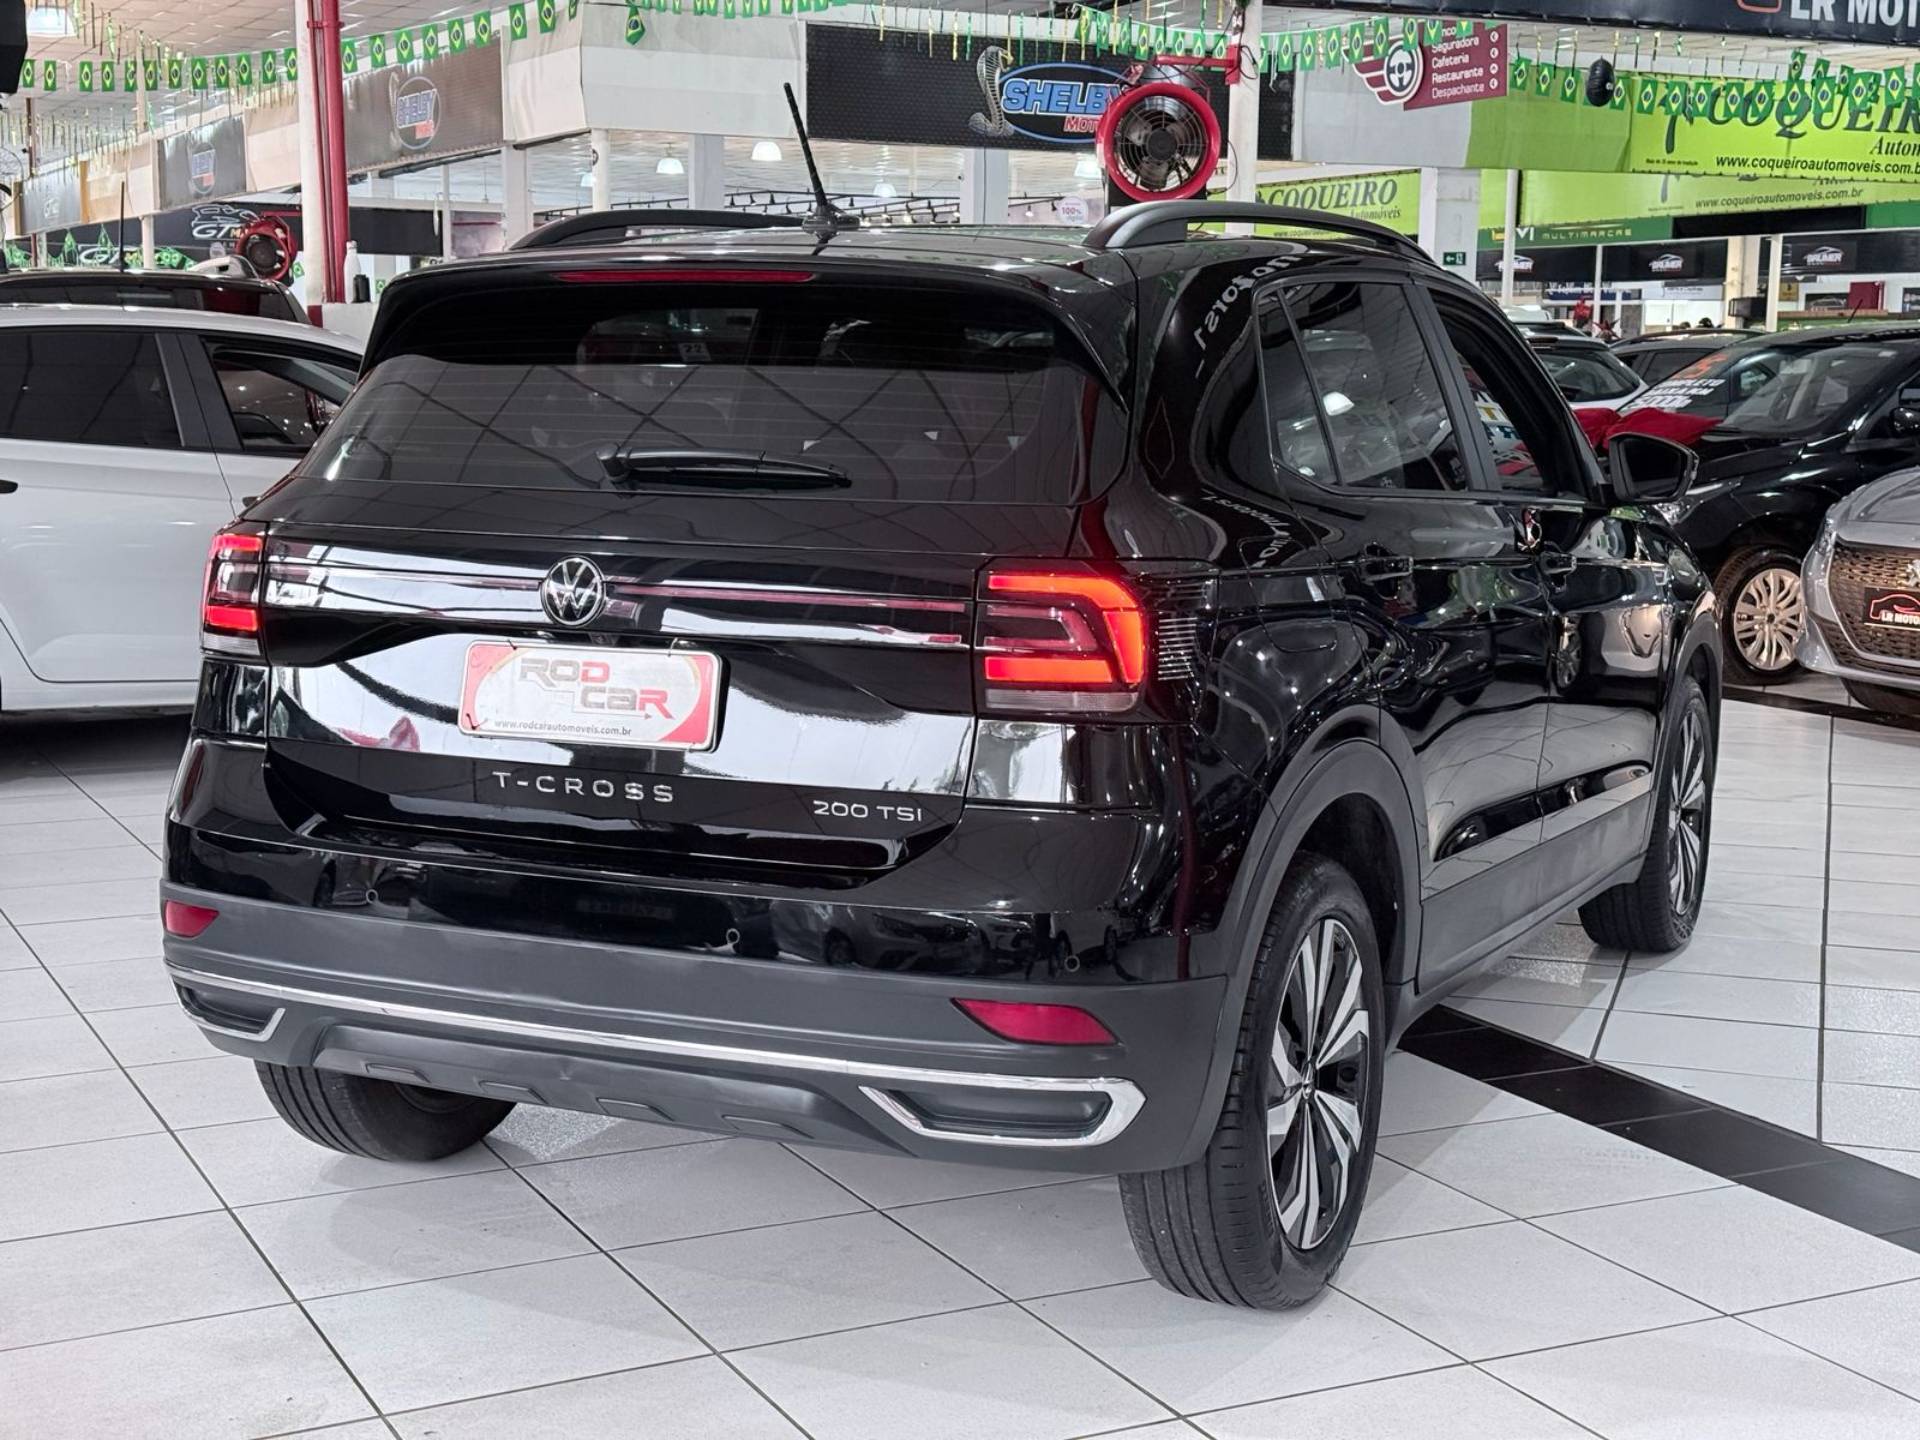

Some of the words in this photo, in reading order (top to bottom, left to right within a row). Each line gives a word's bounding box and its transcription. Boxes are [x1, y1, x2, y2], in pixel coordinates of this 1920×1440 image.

[1432, 36, 1480, 54] Seguradora
[1432, 53, 1469, 69] Cafeteria
[1432, 67, 1484, 84] Restaurante
[1432, 82, 1485, 99] Despachante
[1894, 612, 1920, 626] MOTO
[494, 718, 633, 737] www.rodcarautomoveis.com.br
[492, 771, 674, 803] T-CROSS
[812, 799, 869, 819] 200
[876, 805, 922, 822] TSI
